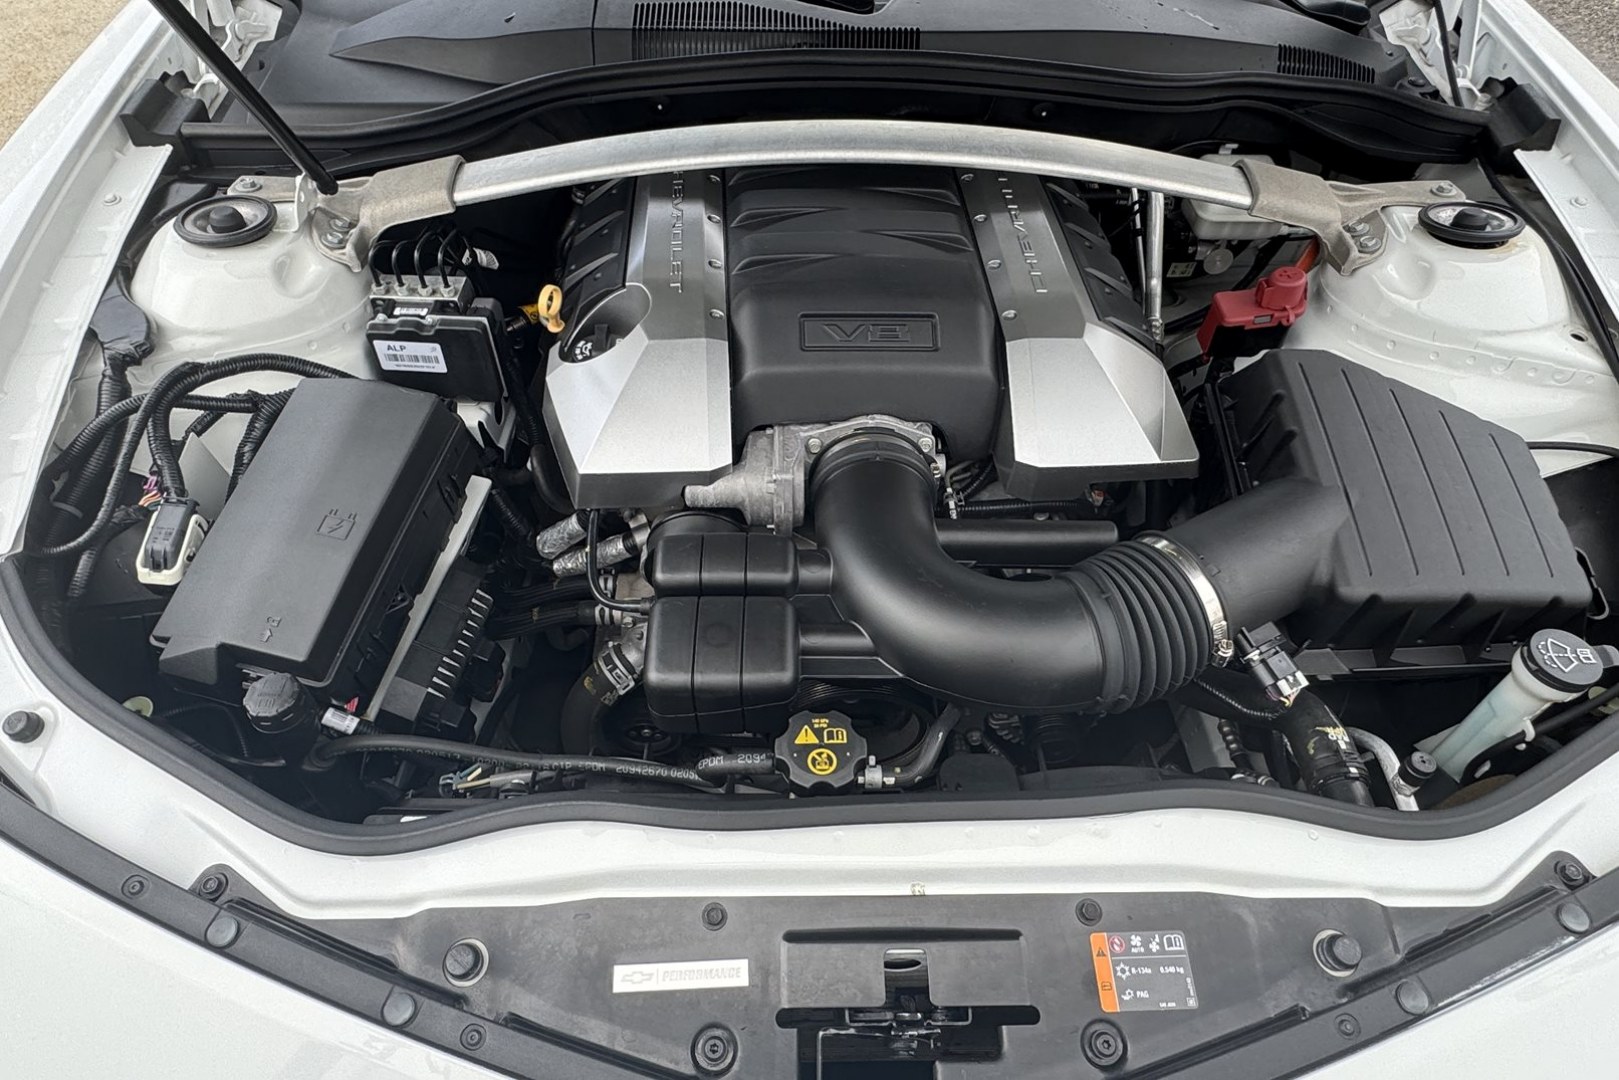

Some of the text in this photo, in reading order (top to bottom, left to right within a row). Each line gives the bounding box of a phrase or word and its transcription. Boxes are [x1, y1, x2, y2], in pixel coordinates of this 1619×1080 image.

[670, 171, 684, 293] HEVROLET
[822, 323, 911, 342] V8
[387, 344, 406, 352] ALP
[697, 755, 724, 770] EPDM
[615, 764, 668, 777] 20942670
[661, 967, 742, 982] PERFORMANCE
[1136, 990, 1149, 998] PAG
